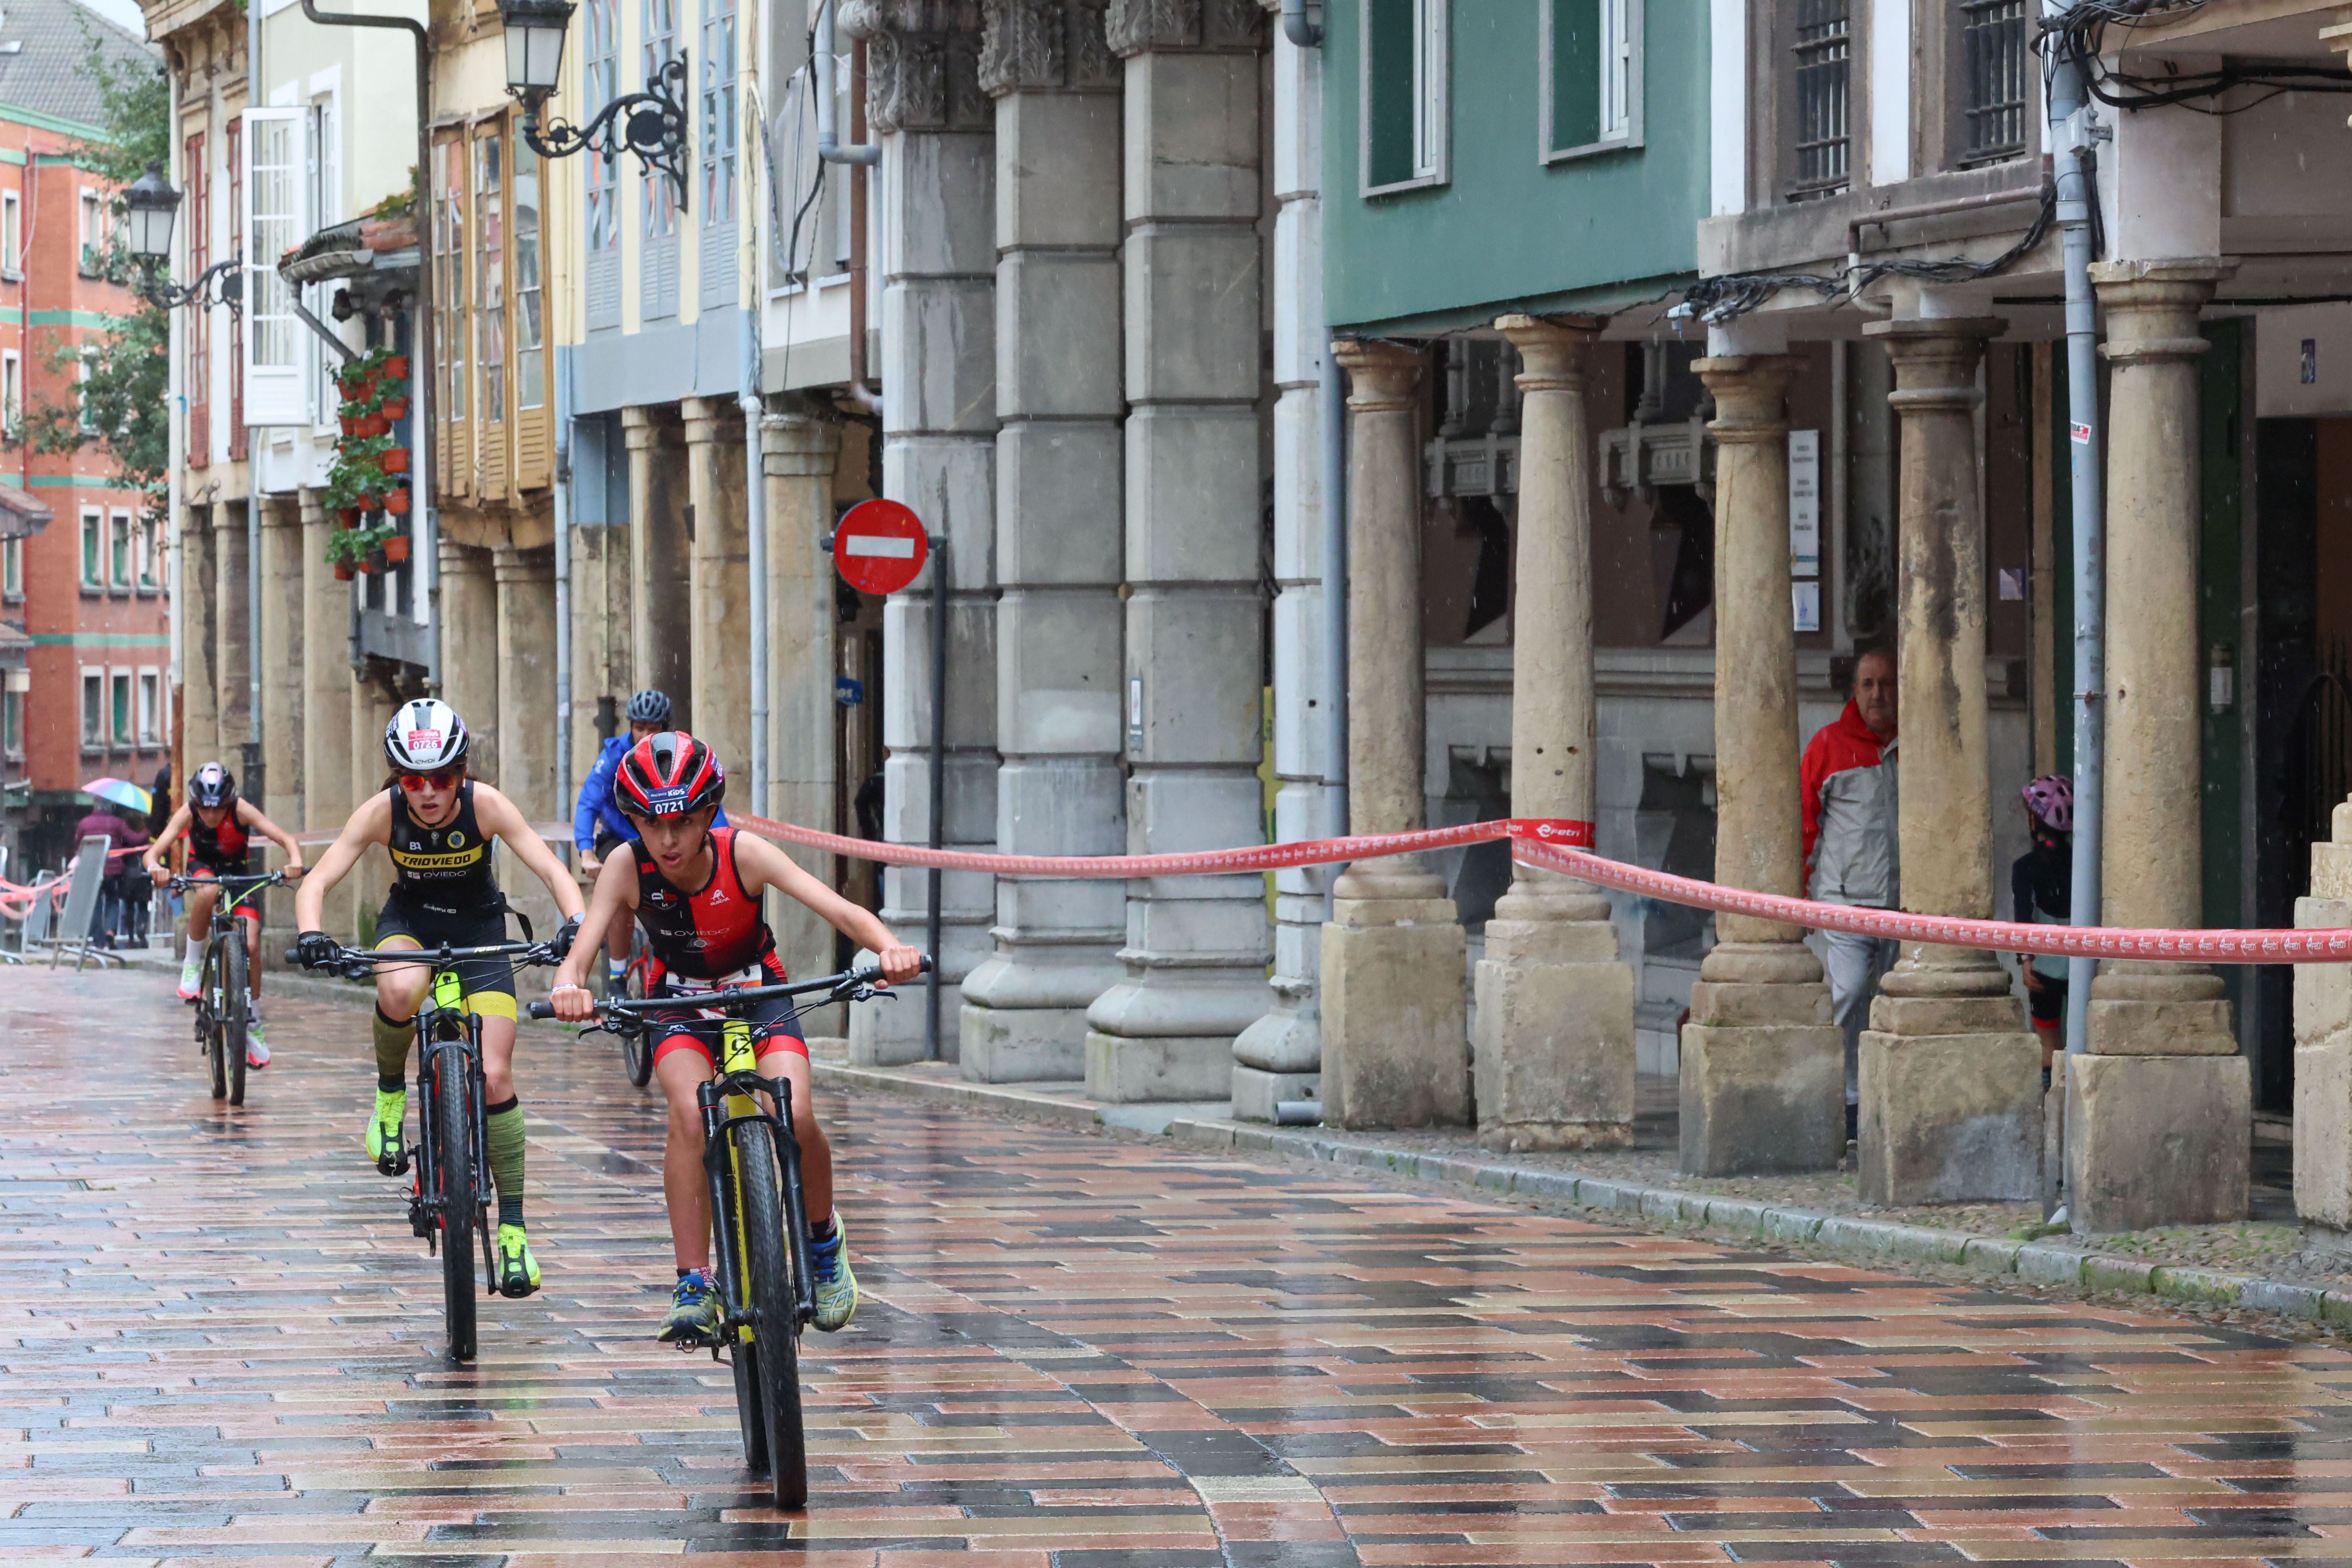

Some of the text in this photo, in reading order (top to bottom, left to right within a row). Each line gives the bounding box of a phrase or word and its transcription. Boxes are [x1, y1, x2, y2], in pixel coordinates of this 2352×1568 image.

[413, 739, 438, 750] 0726
[655, 800, 684, 814] 0721
[403, 854, 471, 866] TRIOVIEDO
[674, 928, 729, 936] OVIEDO
